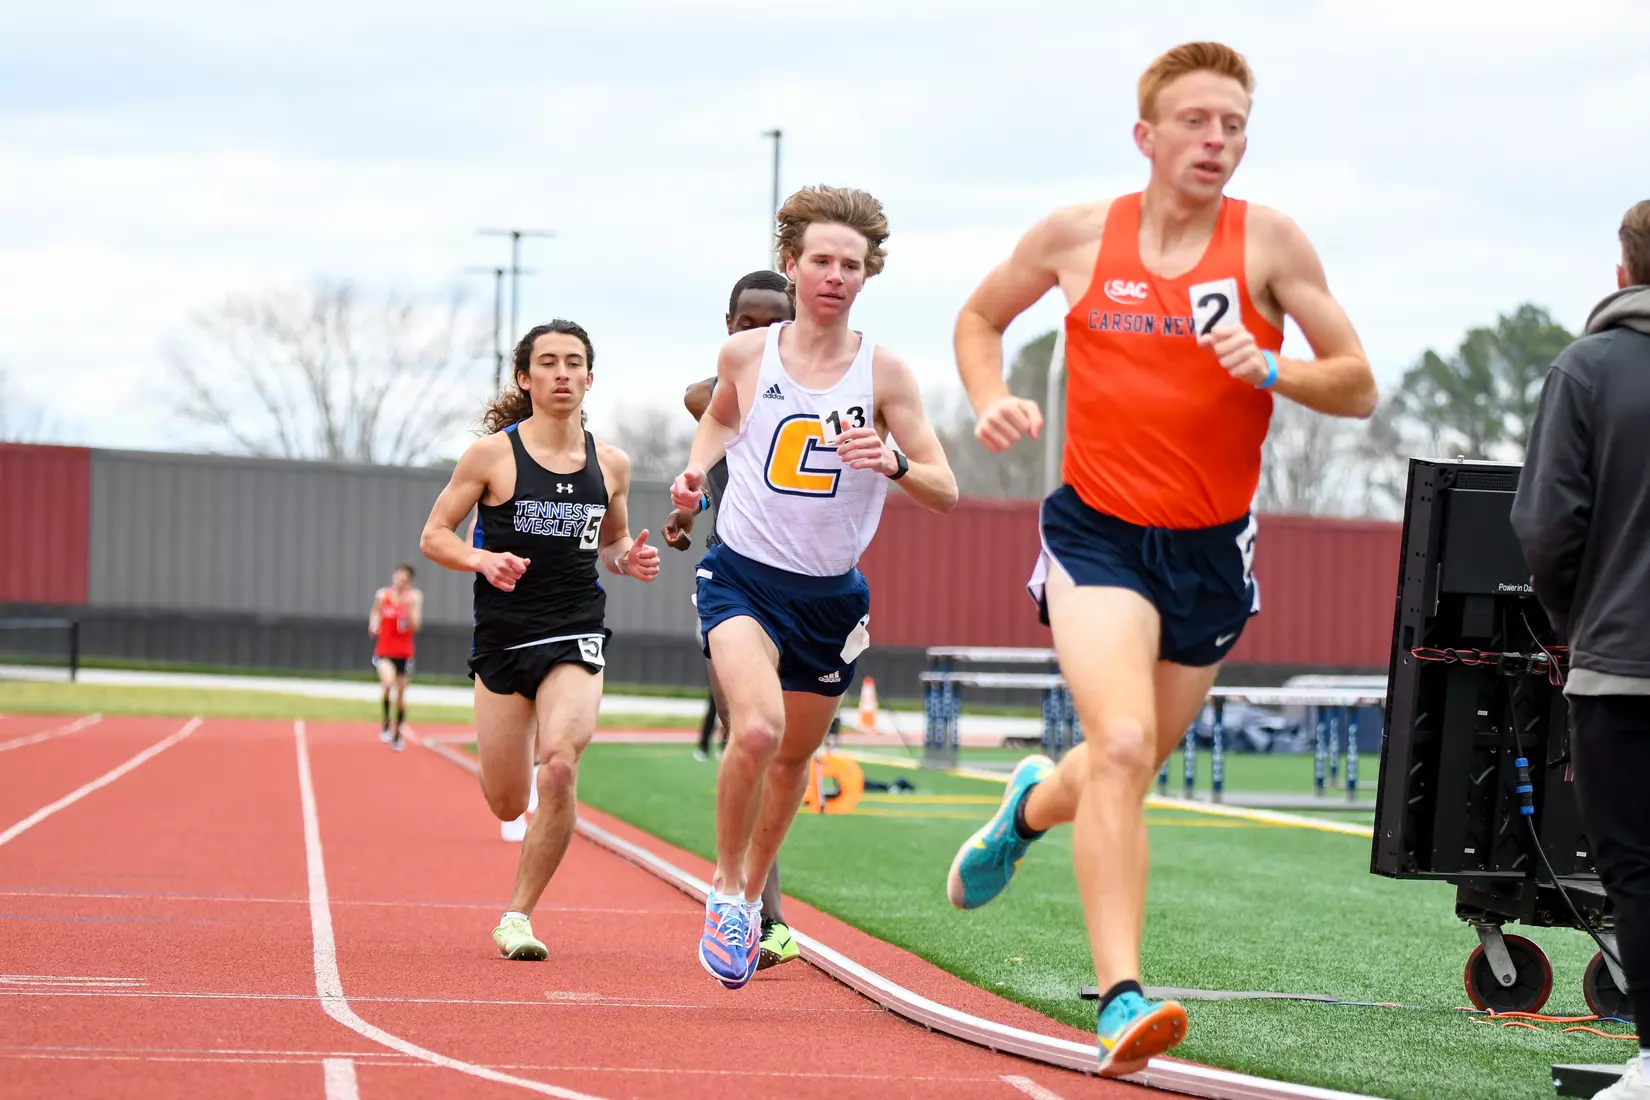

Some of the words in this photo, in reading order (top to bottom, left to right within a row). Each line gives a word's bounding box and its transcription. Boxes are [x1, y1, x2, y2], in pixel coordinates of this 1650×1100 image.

[1110, 280, 1149, 299] SAC
[1197, 292, 1230, 338] 2
[763, 392, 785, 401] adidas
[825, 405, 866, 436] 13
[763, 413, 842, 499] C
[514, 500, 605, 521] TENNESS
[583, 516, 602, 544] 5
